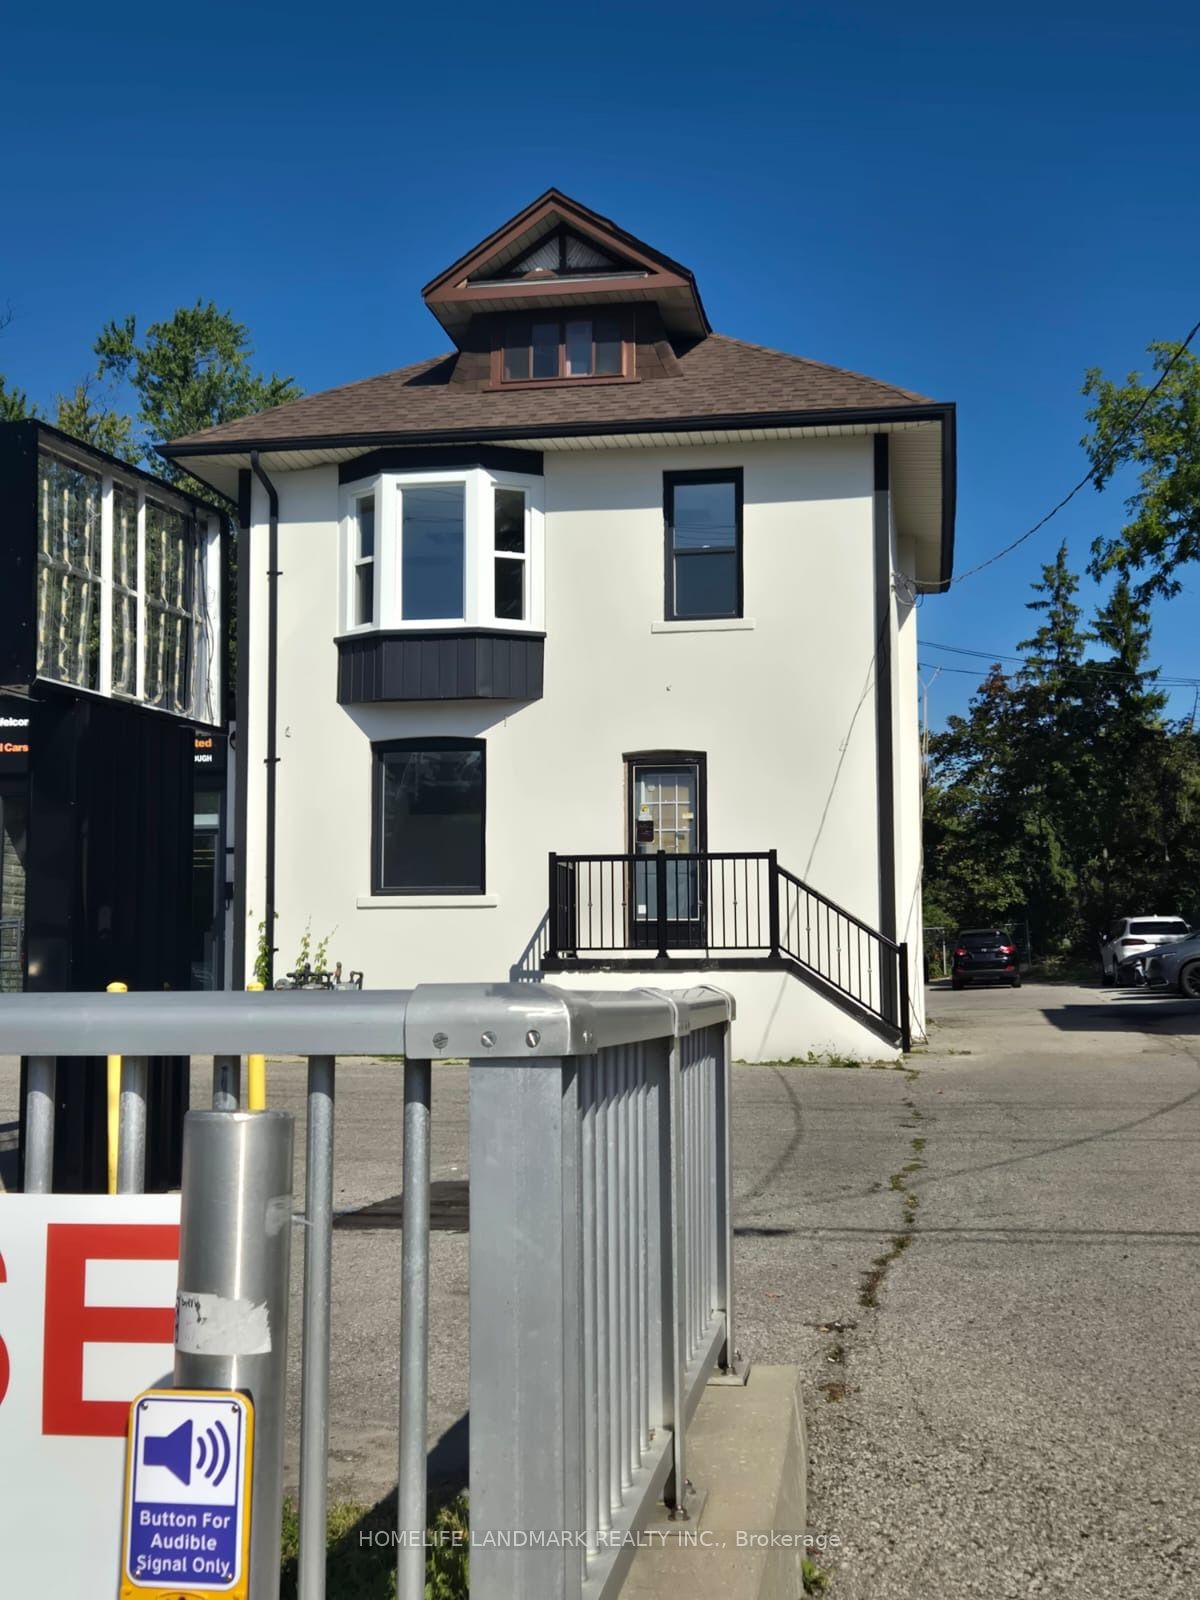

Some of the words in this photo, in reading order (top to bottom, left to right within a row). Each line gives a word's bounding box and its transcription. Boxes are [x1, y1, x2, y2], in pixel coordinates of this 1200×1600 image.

[4, 742, 29, 752] Cars
[140, 1510, 197, 1528] Button
[202, 1512, 231, 1529] For
[150, 1533, 217, 1551] Audible
[137, 1554, 187, 1575] Signal
[192, 1556, 231, 1578] Only
